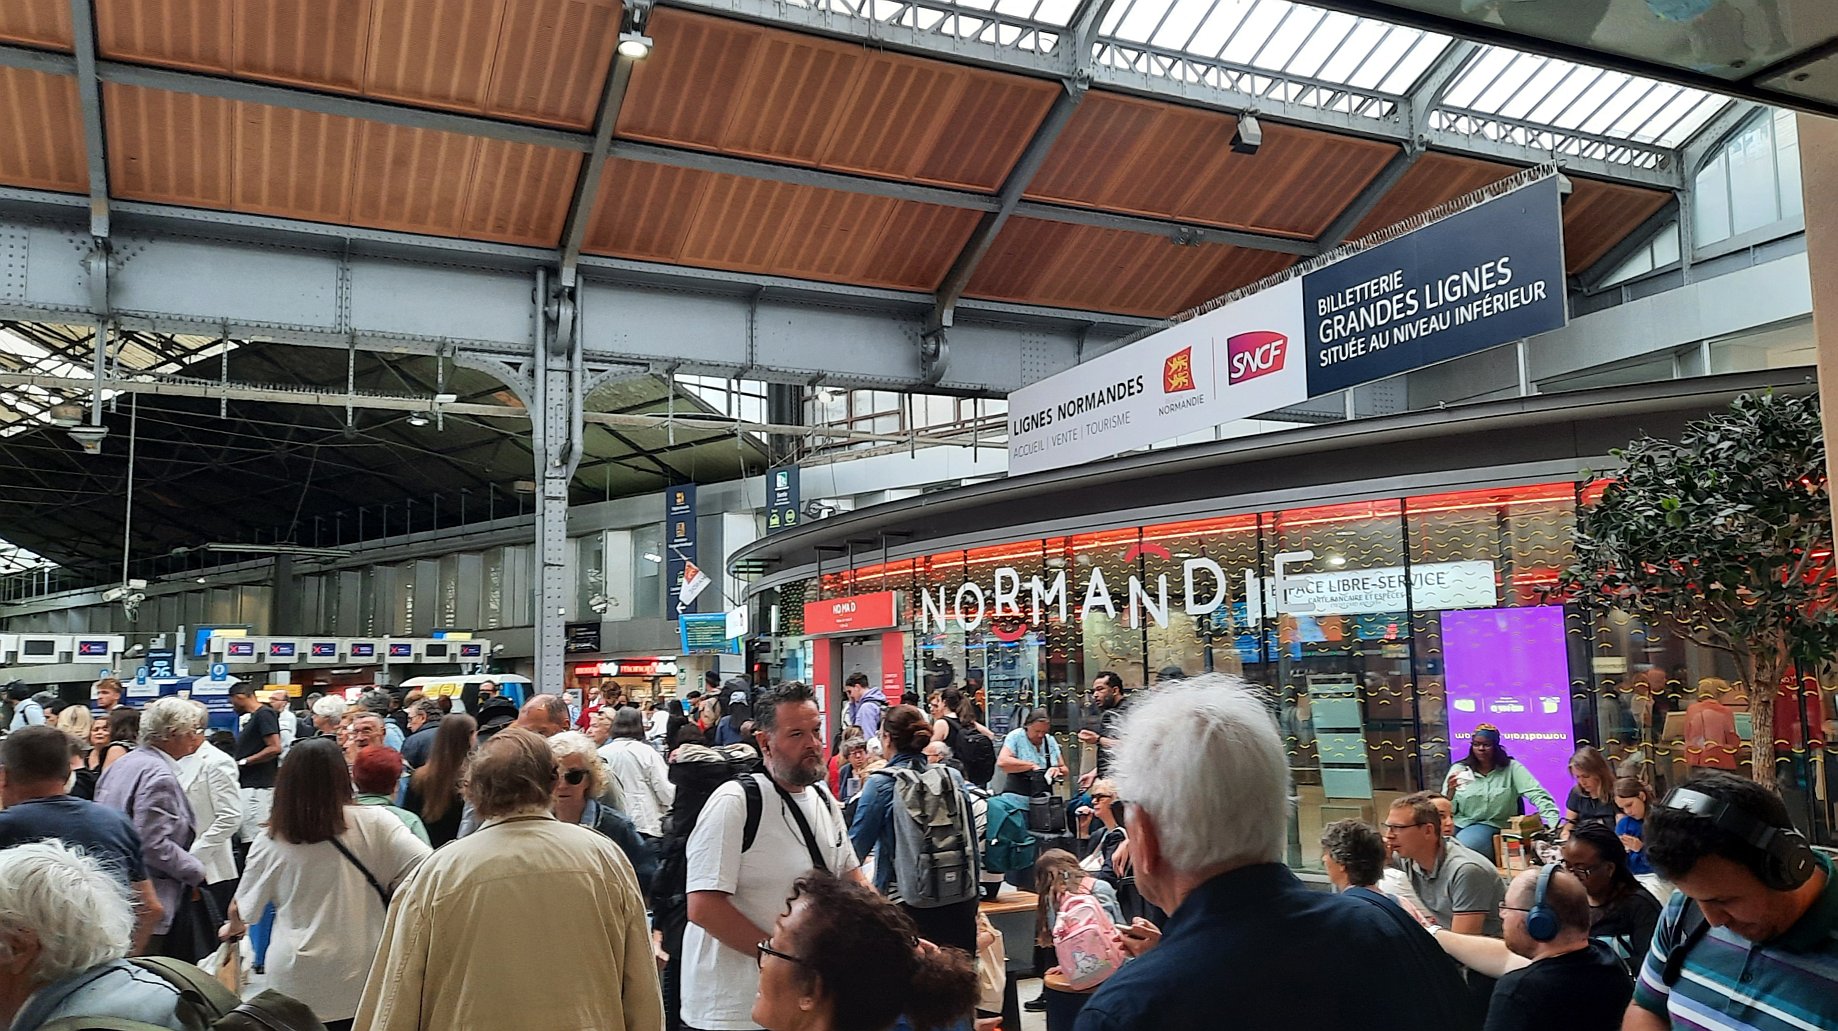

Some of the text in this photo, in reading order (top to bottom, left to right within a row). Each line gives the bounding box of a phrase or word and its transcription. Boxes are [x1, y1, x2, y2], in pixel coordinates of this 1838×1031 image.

[1317, 269, 1404, 317] BILLETTERIE
[1318, 256, 1513, 344] GRANDES LIGNES
[1319, 280, 1547, 368] SITUÉE AU NIVEAU INFÉRIEUR
[1230, 339, 1285, 379] SNCF
[1013, 375, 1144, 436] LIGNES NORMANDES
[1158, 394, 1205, 416] NORMANDIE
[1013, 411, 1131, 459] ACCUEIL VENTE TOURISME
[921, 549, 1314, 634] NORMANDIE
[151, 666, 171, 677] 26
[1455, 732, 1567, 741] nomadtrain.om
